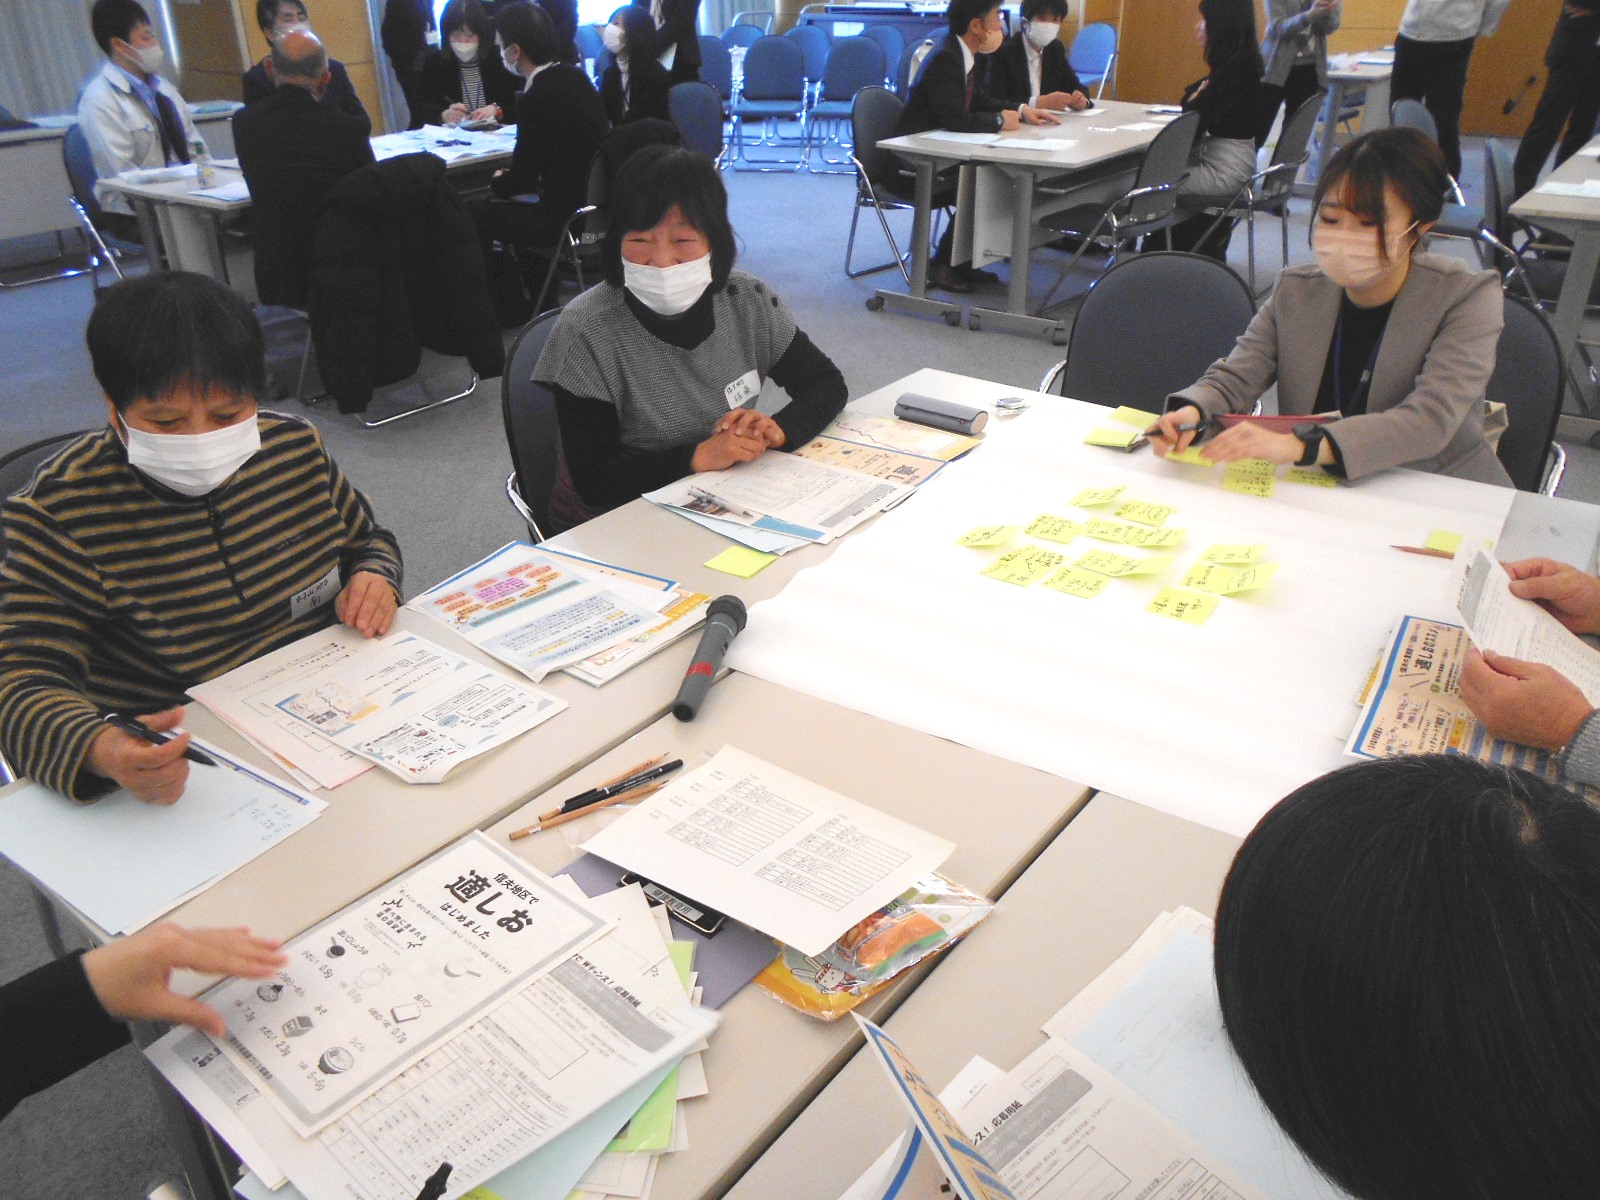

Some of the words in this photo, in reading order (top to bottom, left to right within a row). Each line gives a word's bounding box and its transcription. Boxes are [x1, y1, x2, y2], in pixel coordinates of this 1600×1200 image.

[443, 869, 533, 933] 適しお
[493, 872, 540, 905] 信夫地区で
[439, 902, 492, 940] はじめました
